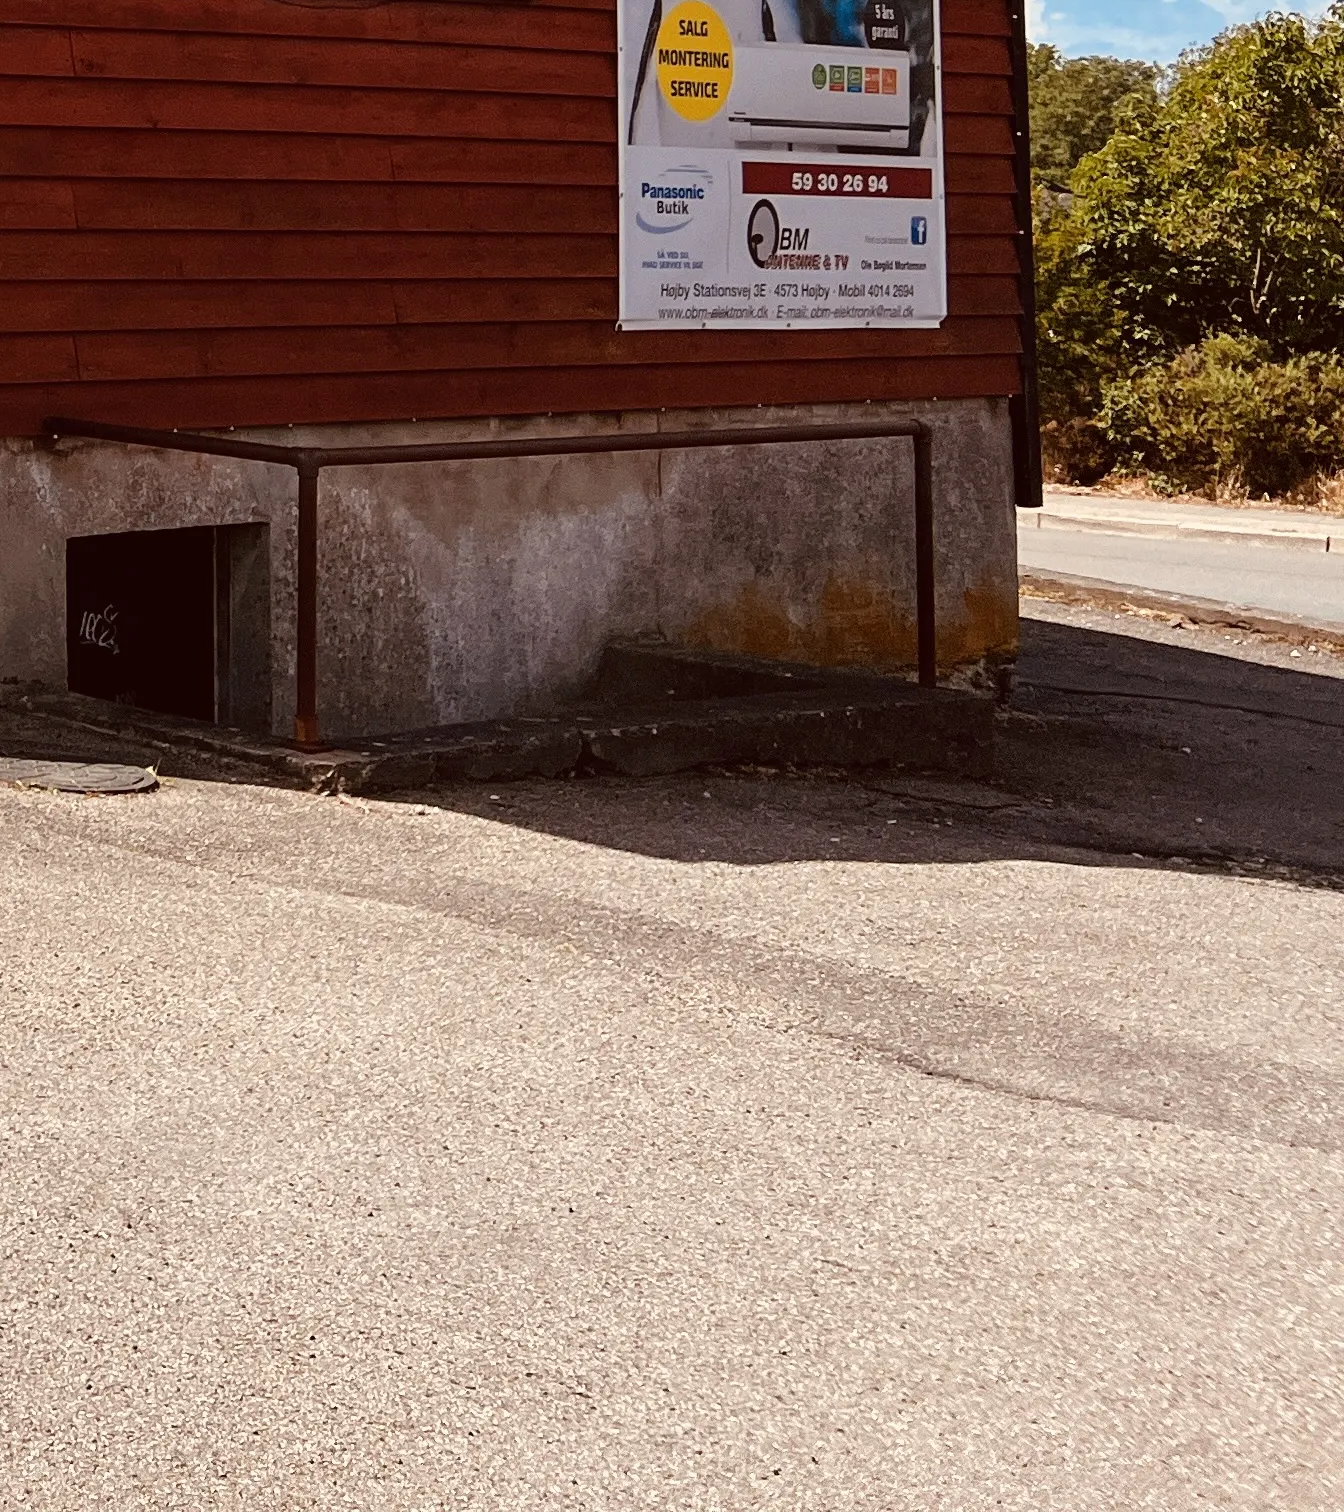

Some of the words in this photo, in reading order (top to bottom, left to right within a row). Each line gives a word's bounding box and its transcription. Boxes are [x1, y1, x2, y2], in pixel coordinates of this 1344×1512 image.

[875, 4, 881, 19] 5
[882, 4, 894, 20] års
[679, 20, 708, 37] SALG
[872, 25, 899, 41] garanti
[658, 49, 730, 69] MONTERING
[670, 80, 719, 99] SERVICE
[641, 182, 705, 200] Panasonic
[791, 172, 813, 190] 59
[817, 174, 838, 191] 30
[842, 174, 864, 192] 26
[868, 175, 889, 193] 94
[656, 200, 690, 215] Butik
[822, 254, 832, 271] &
[834, 254, 849, 271] TV
[660, 283, 690, 301] Højby
[692, 283, 751, 301] Stationsvej
[753, 283, 767, 297] 3E
[773, 284, 799, 297] 4573
[838, 284, 866, 297] Mobil
[867, 284, 890, 297] 4014
[658, 306, 769, 319] www.obm-elektronik.dk
